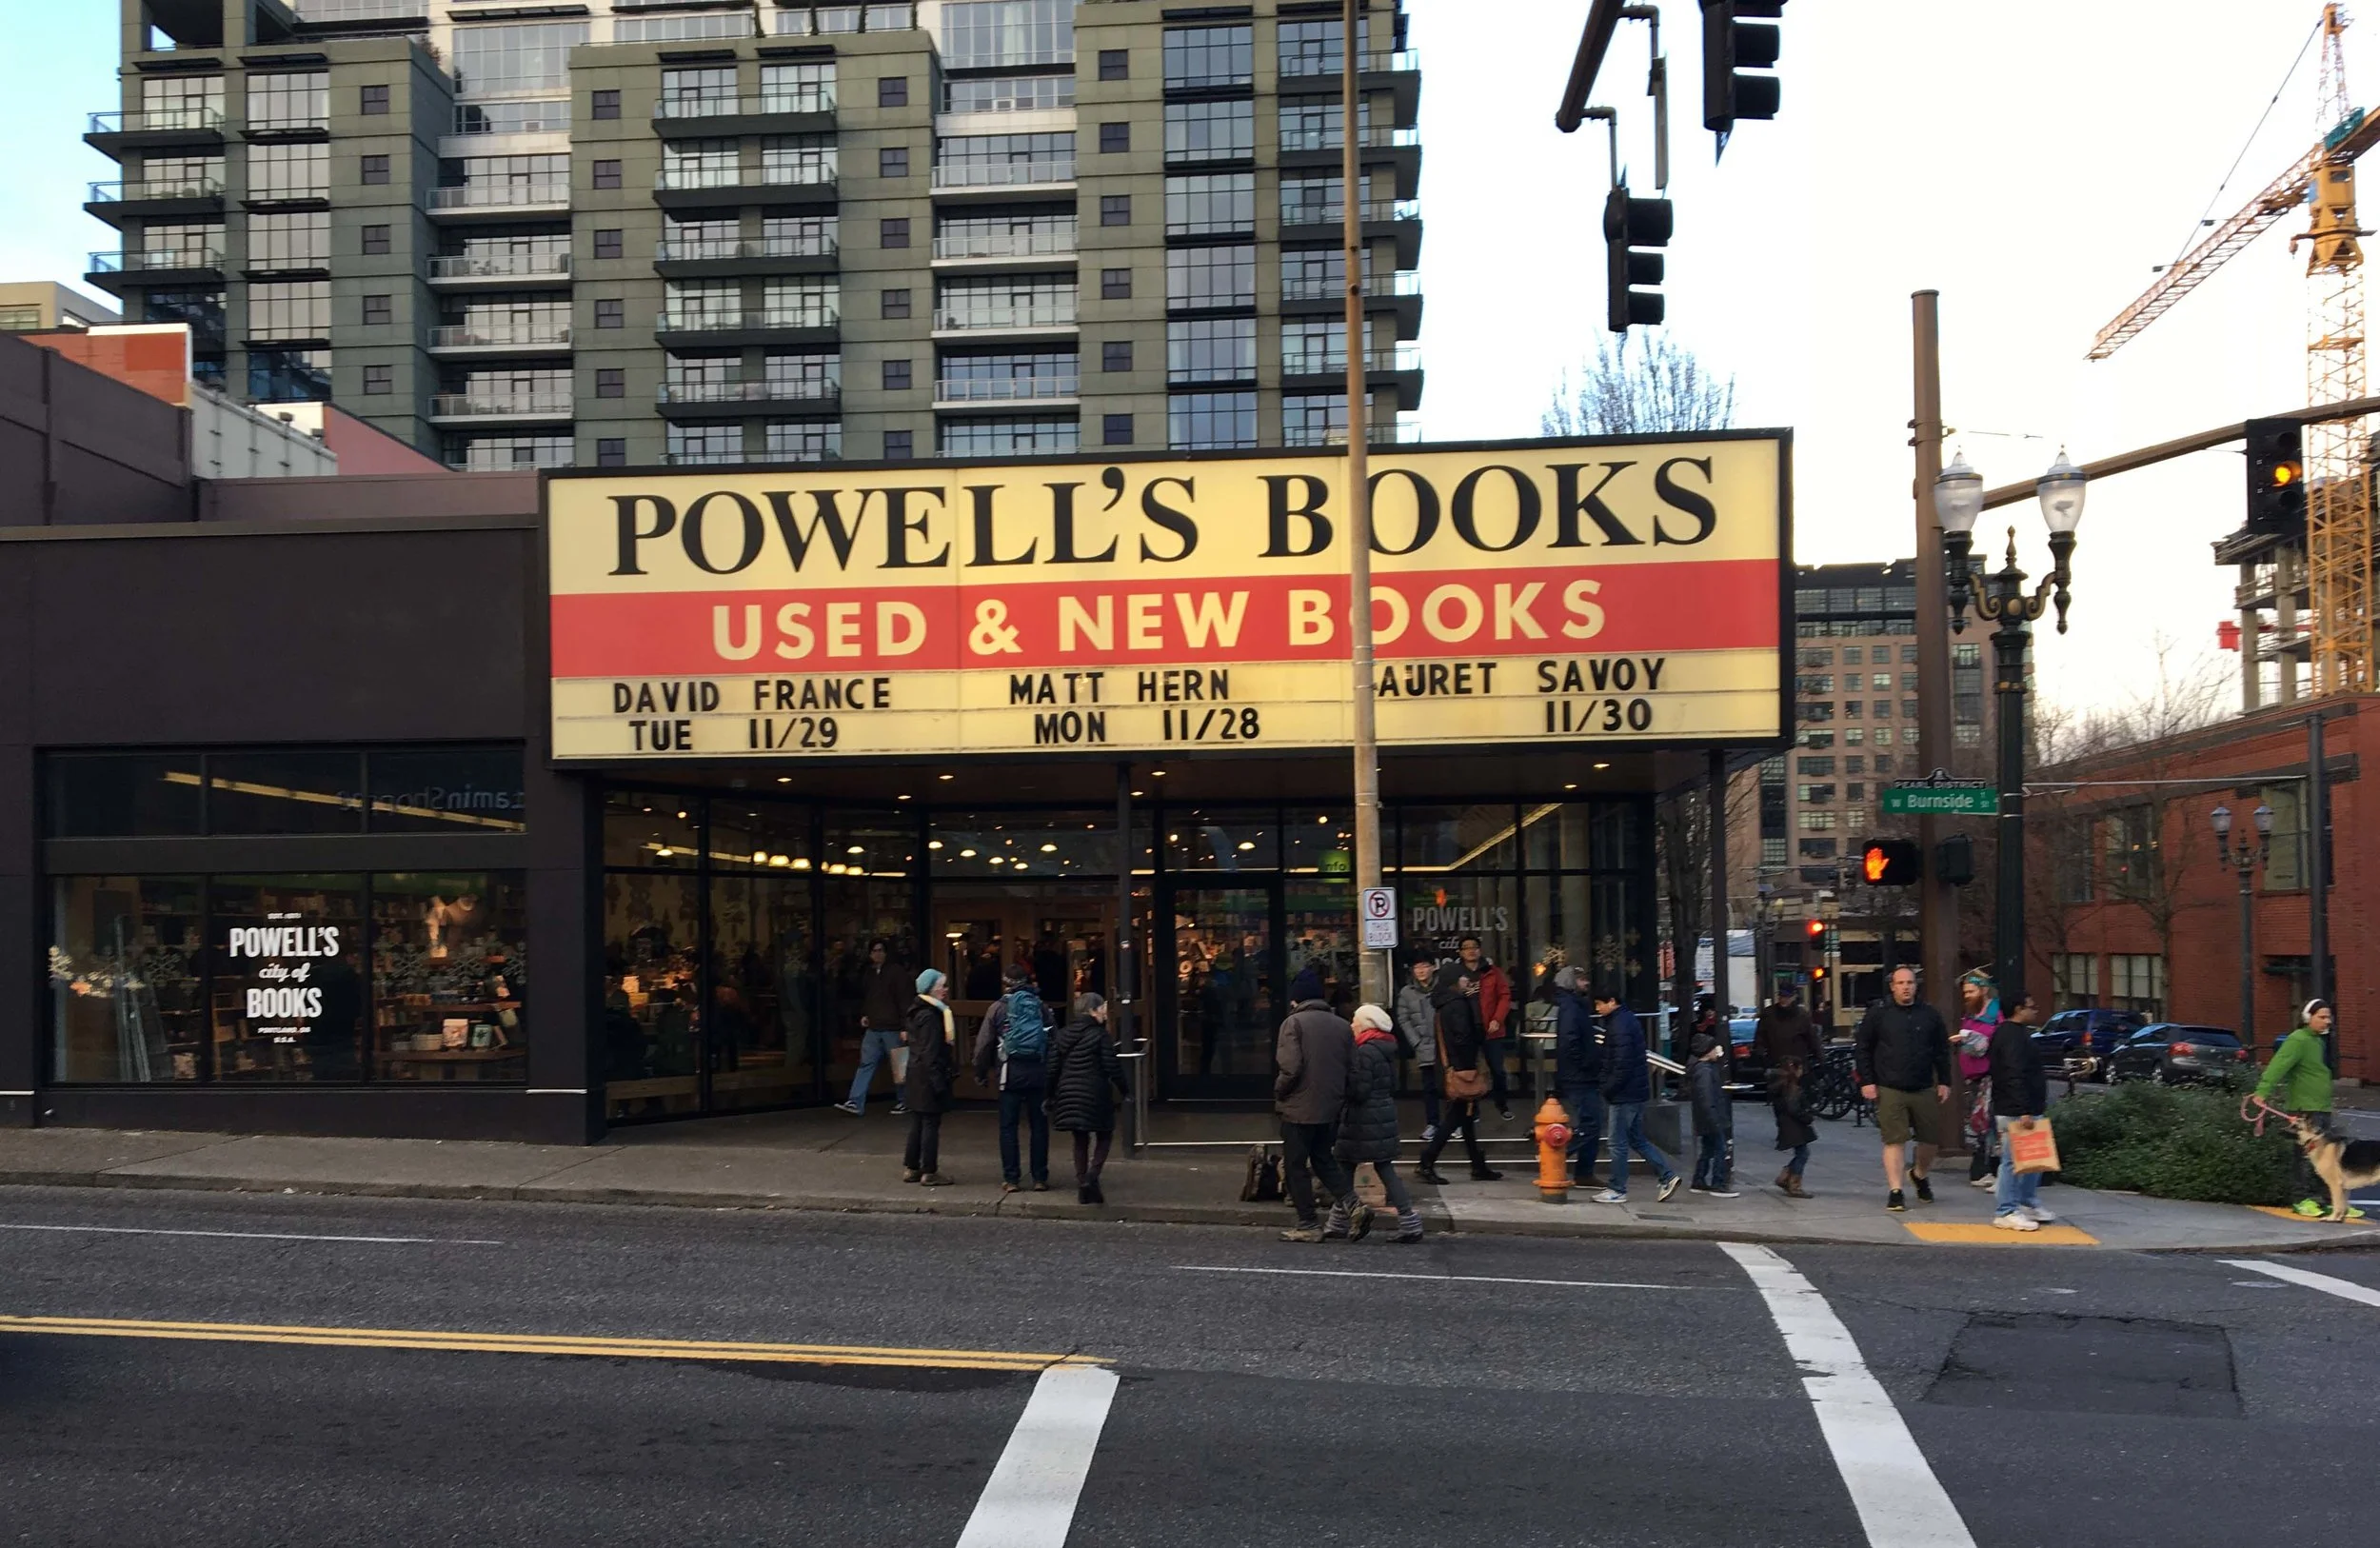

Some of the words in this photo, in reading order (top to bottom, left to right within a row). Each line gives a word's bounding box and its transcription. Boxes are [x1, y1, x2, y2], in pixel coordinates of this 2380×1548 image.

[607, 466, 1198, 576] POWELL'S
[1259, 456, 1716, 558] BOOKS
[713, 601, 926, 661] USED
[968, 599, 1022, 656] &
[1059, 591, 1249, 652] NEW
[1289, 579, 1605, 645] BOOKS
[1010, 671, 1104, 705] MATT
[1138, 669, 1228, 703] HERN
[1378, 662, 1497, 697] AURET
[1537, 657, 1665, 693] SAVOY
[614, 681, 720, 714] DAVID
[754, 677, 889, 711] FRANCE
[1035, 710, 1105, 744] MON
[1163, 707, 1259, 741] 11/28
[1546, 698, 1653, 733] 11/30
[628, 719, 692, 751] TUE
[749, 716, 838, 749] 11/29
[1907, 793, 1973, 808] Burnside
[1412, 906, 1508, 932] POWELL'S
[229, 926, 340, 958] POWELL'S
[258, 963, 290, 983] city
[290, 962, 311, 983] of
[247, 986, 323, 1019] BOOKS
